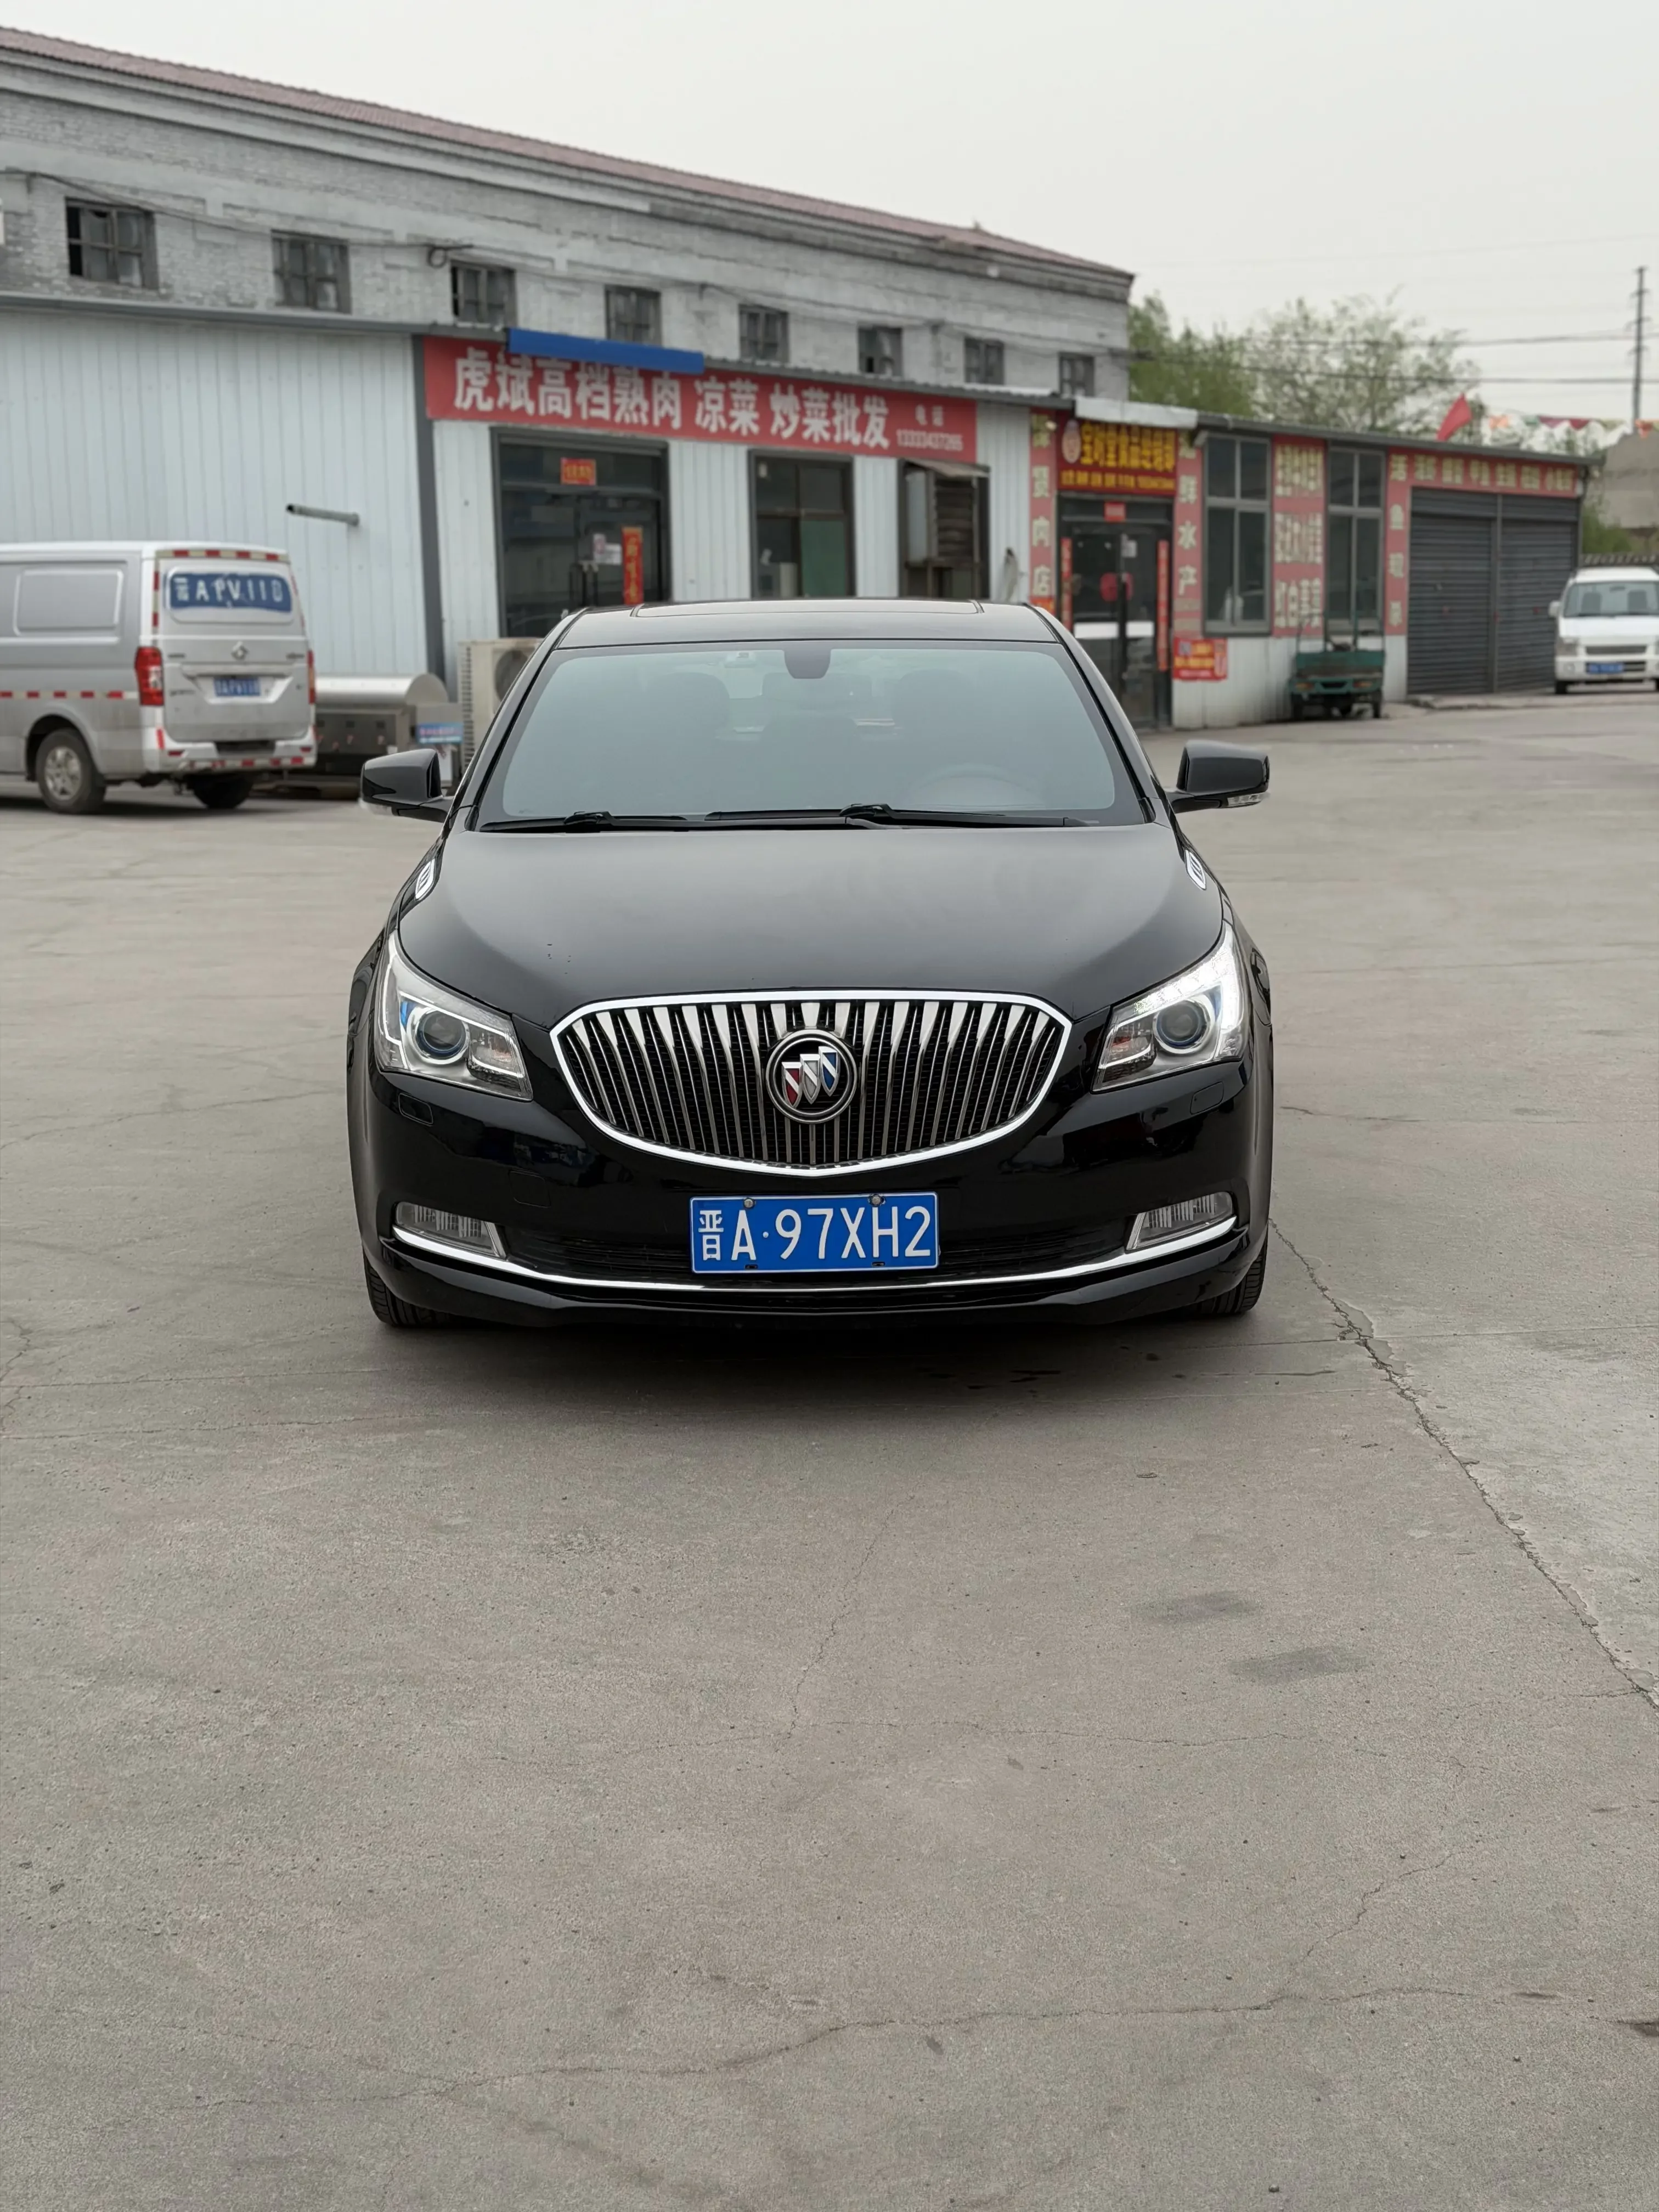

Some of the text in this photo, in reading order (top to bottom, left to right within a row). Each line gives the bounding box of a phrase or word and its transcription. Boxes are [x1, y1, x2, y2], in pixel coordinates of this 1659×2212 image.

[694, 376, 760, 437] 凉菜
[770, 383, 889, 450] 炒菜批发
[698, 1206, 931, 1261] 晋A·97XH2
